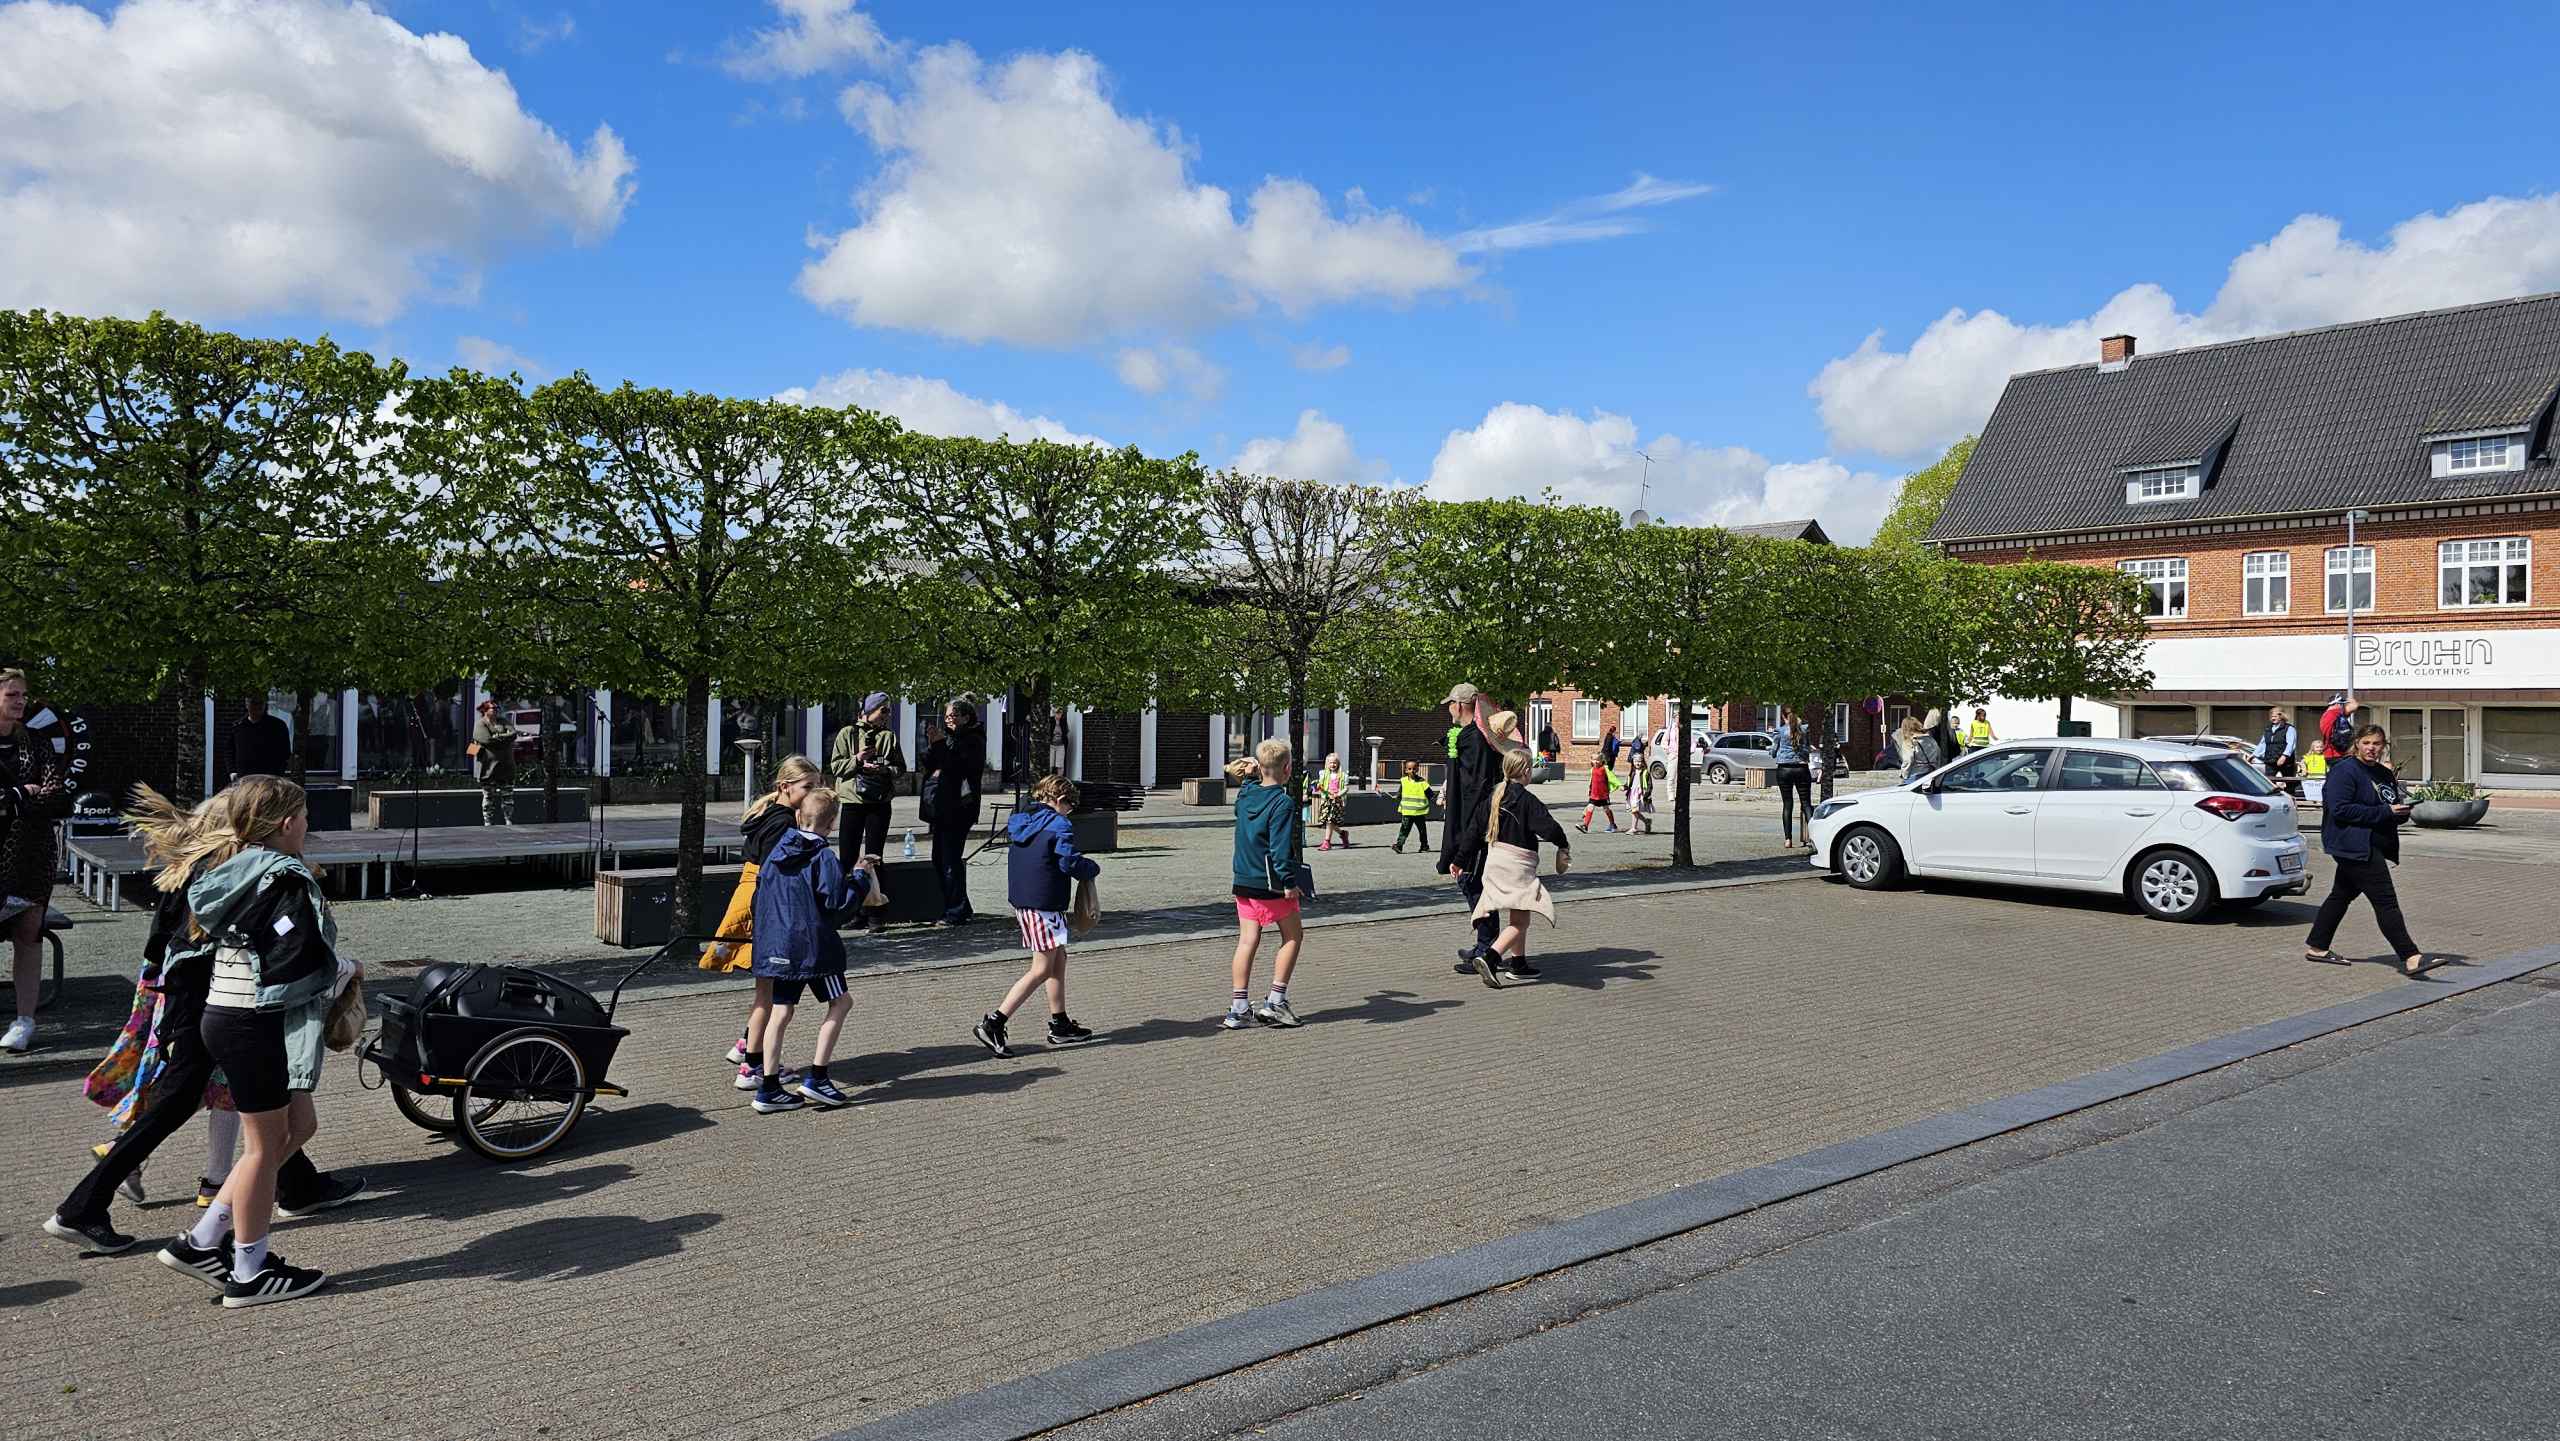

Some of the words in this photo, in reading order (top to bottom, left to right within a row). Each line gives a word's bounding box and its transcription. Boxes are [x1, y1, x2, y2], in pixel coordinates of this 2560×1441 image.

[2374, 668, 2409, 676] LOCAL
[2414, 667, 2471, 676] CLOTHING
[70, 717, 87, 733] 13
[83, 806, 111, 817] sport
